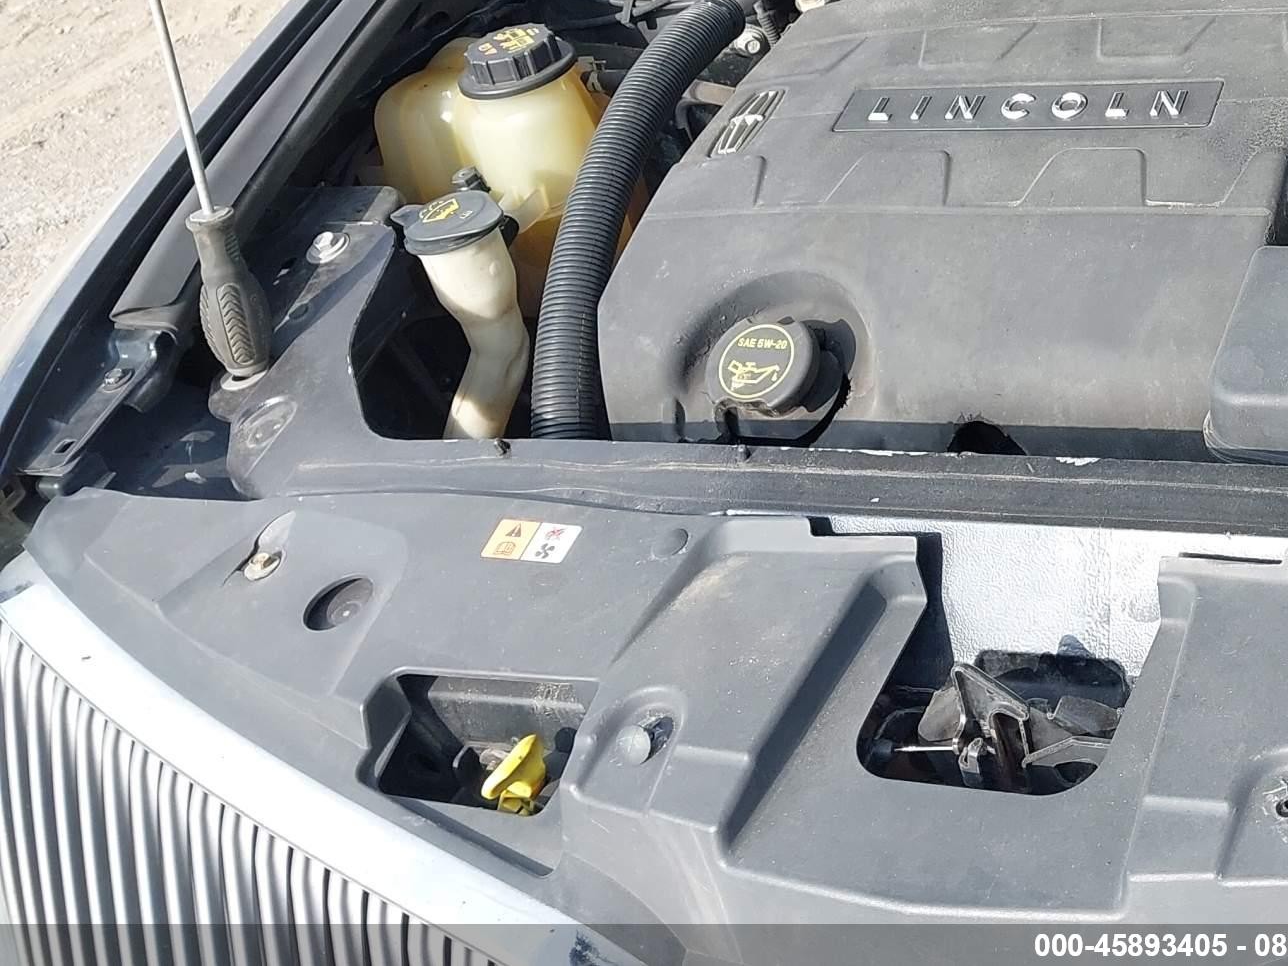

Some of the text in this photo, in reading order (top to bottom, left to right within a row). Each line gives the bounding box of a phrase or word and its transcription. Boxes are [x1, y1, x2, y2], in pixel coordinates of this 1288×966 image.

[867, 89, 1188, 121] LINCOLN
[737, 337, 788, 350] SAE 5W-20
